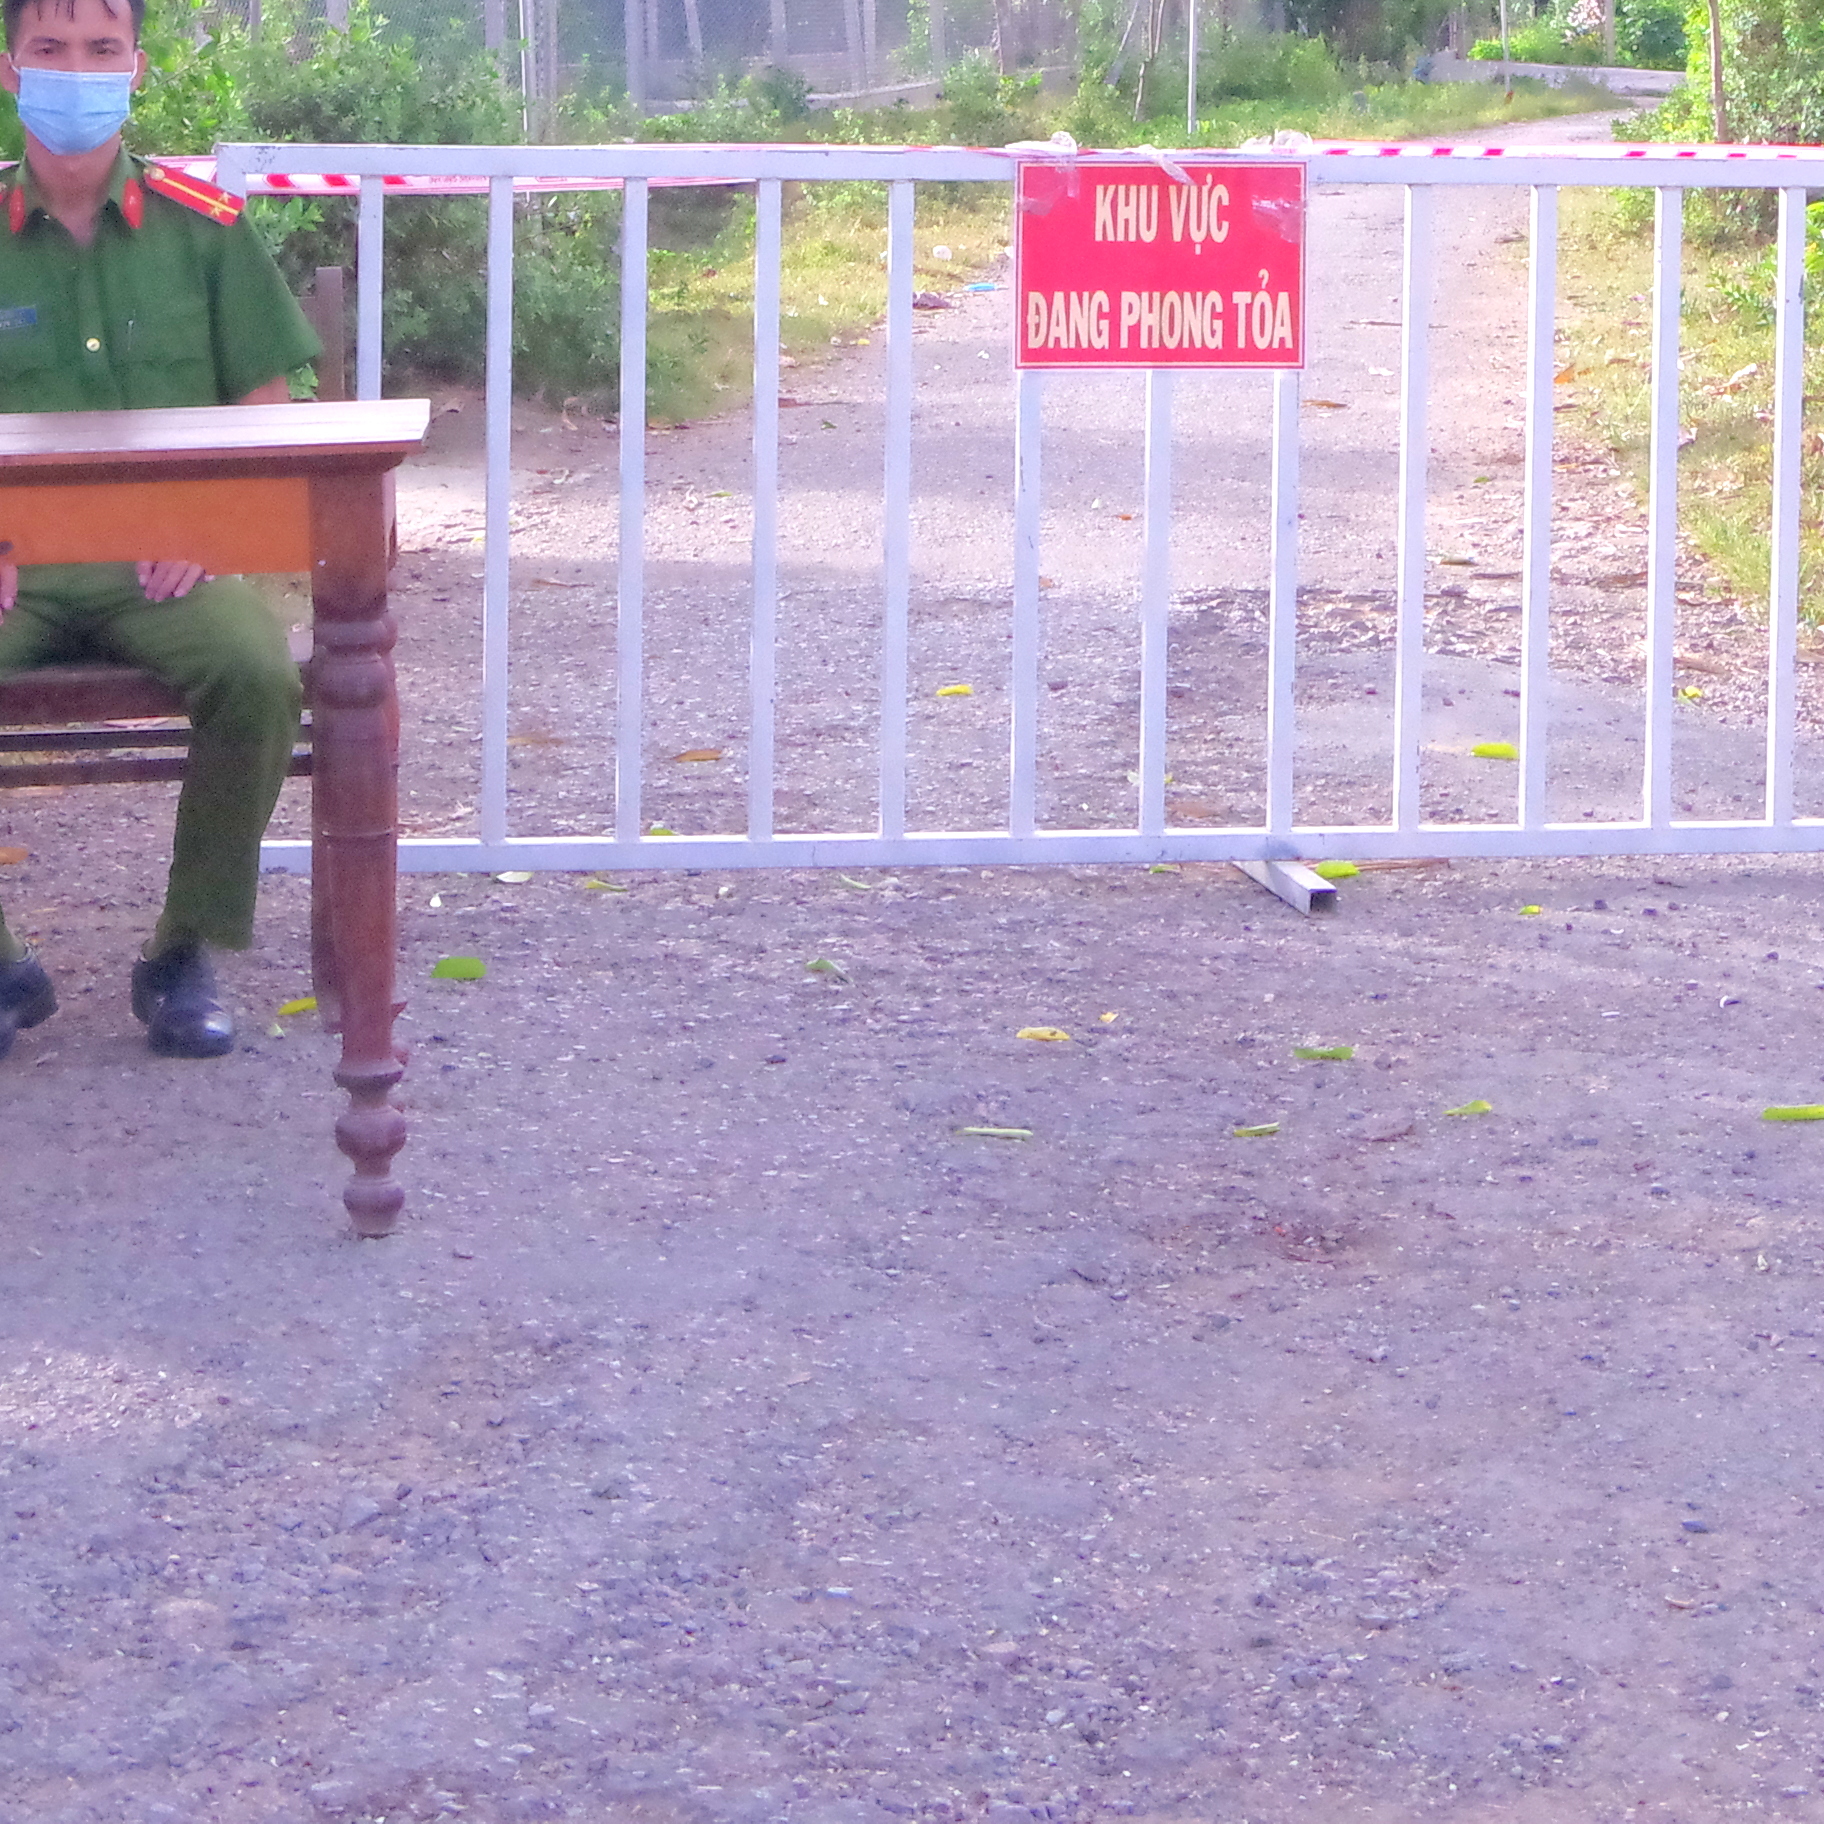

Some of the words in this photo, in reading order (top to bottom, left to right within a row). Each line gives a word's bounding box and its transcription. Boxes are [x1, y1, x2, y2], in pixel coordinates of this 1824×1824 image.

[1095, 185, 1159, 242] KHU
[1168, 173, 1230, 255] VỰC
[1027, 290, 1110, 349] ĐANG
[1120, 290, 1224, 349] PHONG
[1232, 268, 1293, 349] TỎA
